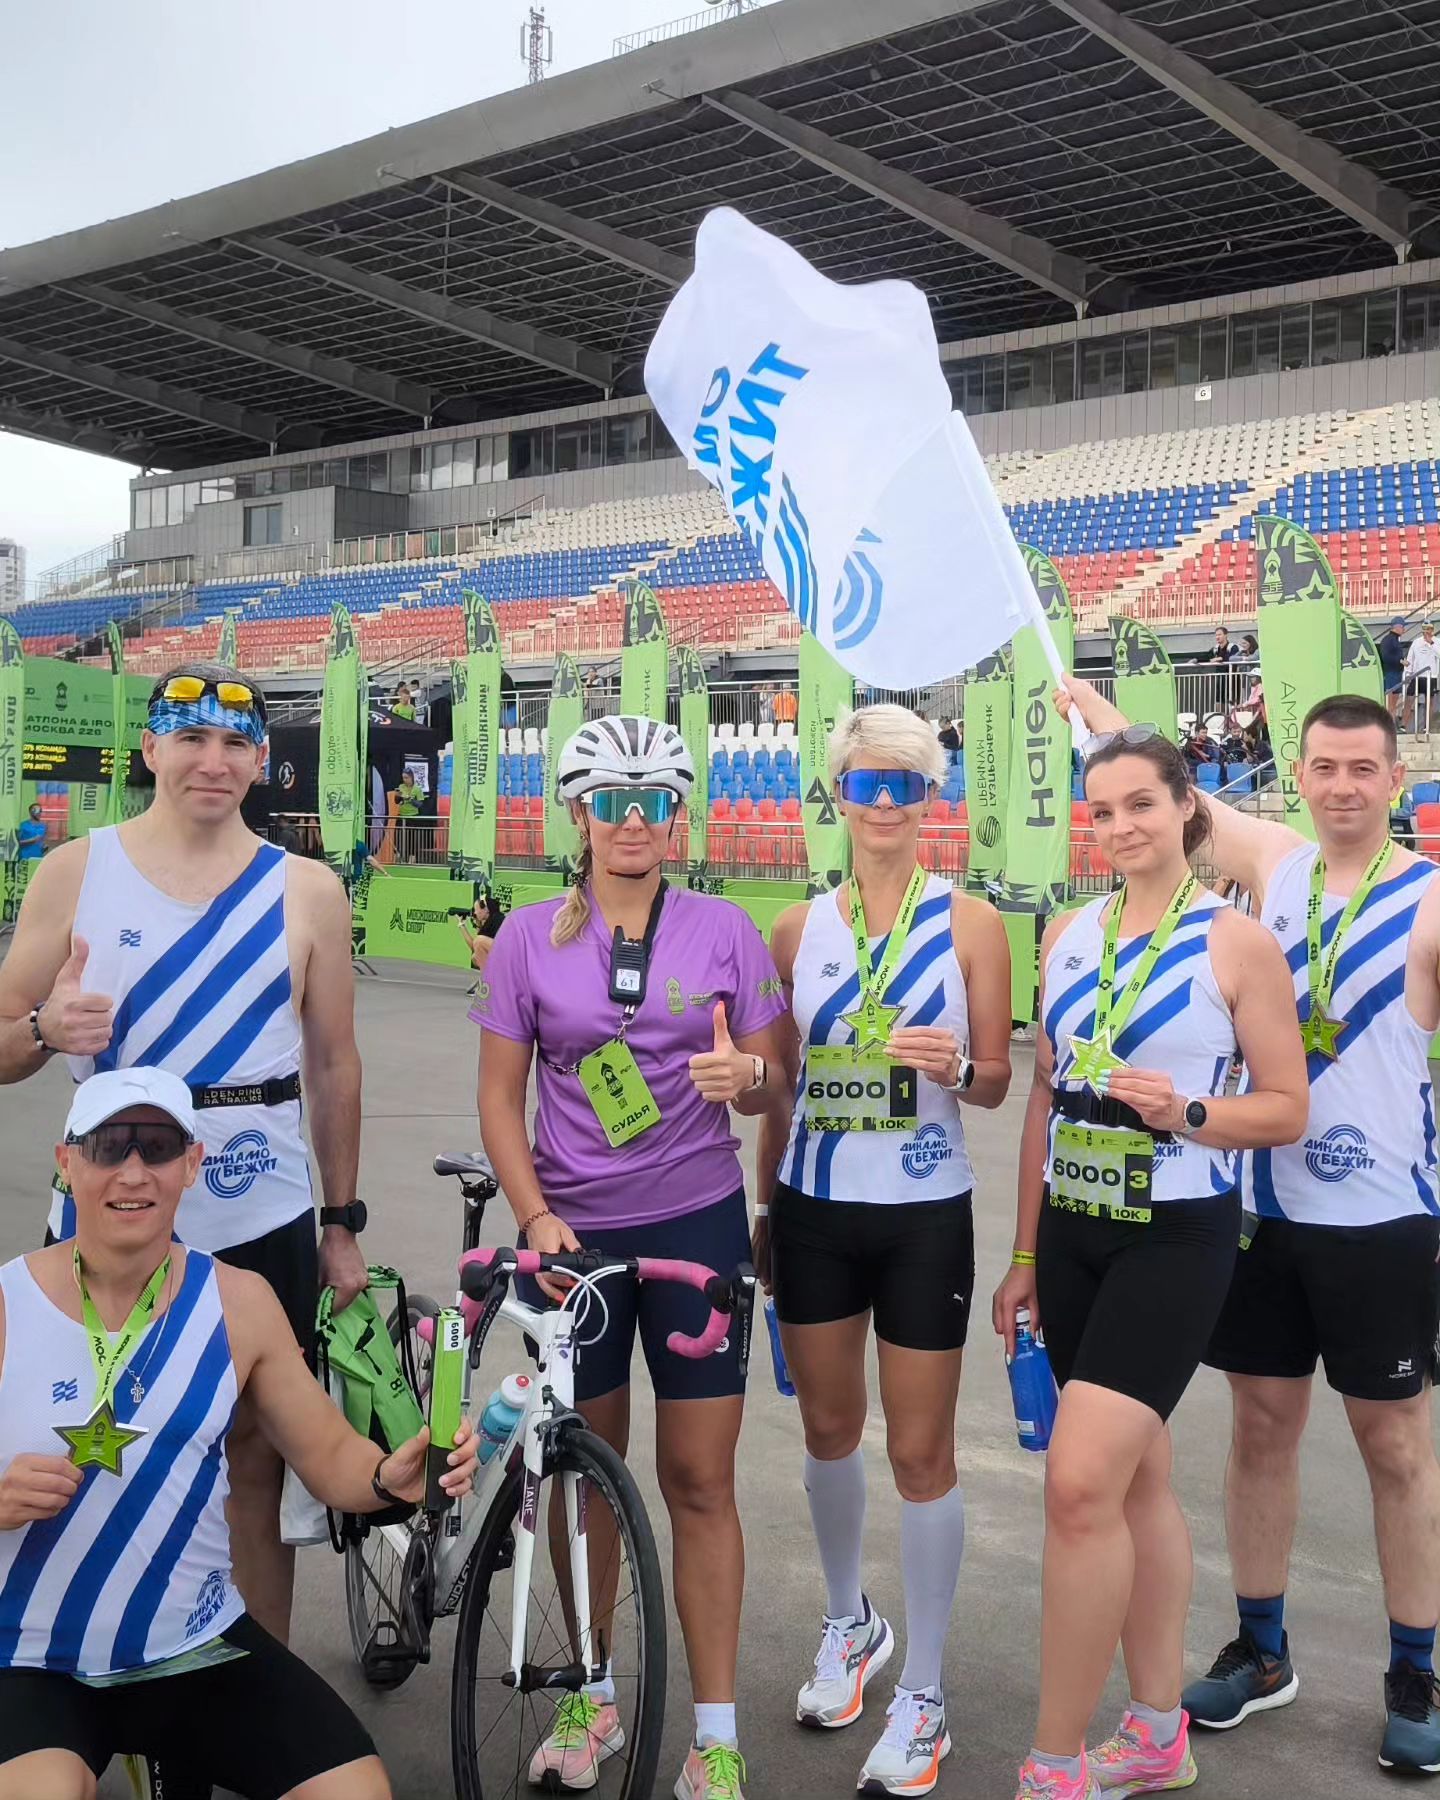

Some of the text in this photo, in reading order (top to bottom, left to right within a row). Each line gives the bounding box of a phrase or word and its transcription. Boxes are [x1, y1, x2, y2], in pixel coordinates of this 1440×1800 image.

[728, 341, 810, 512] ЖИТ
[1322, 931, 1342, 988] МОСКВА
[808, 1080, 909, 1099] 6000 1
[611, 1104, 651, 1134] СУДЬЯ
[879, 1119, 907, 1129] 10K
[900, 1139, 948, 1151] ДИНАМО
[1303, 1138, 1369, 1157] ДИНАМО
[201, 1147, 270, 1167] ДИНАМО
[915, 1148, 953, 1163] БЕЖИТ
[1321, 1152, 1377, 1169] БЕЖИТ
[223, 1157, 278, 1178] БЕЖИТ
[1053, 1157, 1149, 1190] 6000 3
[1114, 1208, 1140, 1220] 10K
[450, 1322, 460, 1348] 6000
[523, 1485, 534, 1516] JANE
